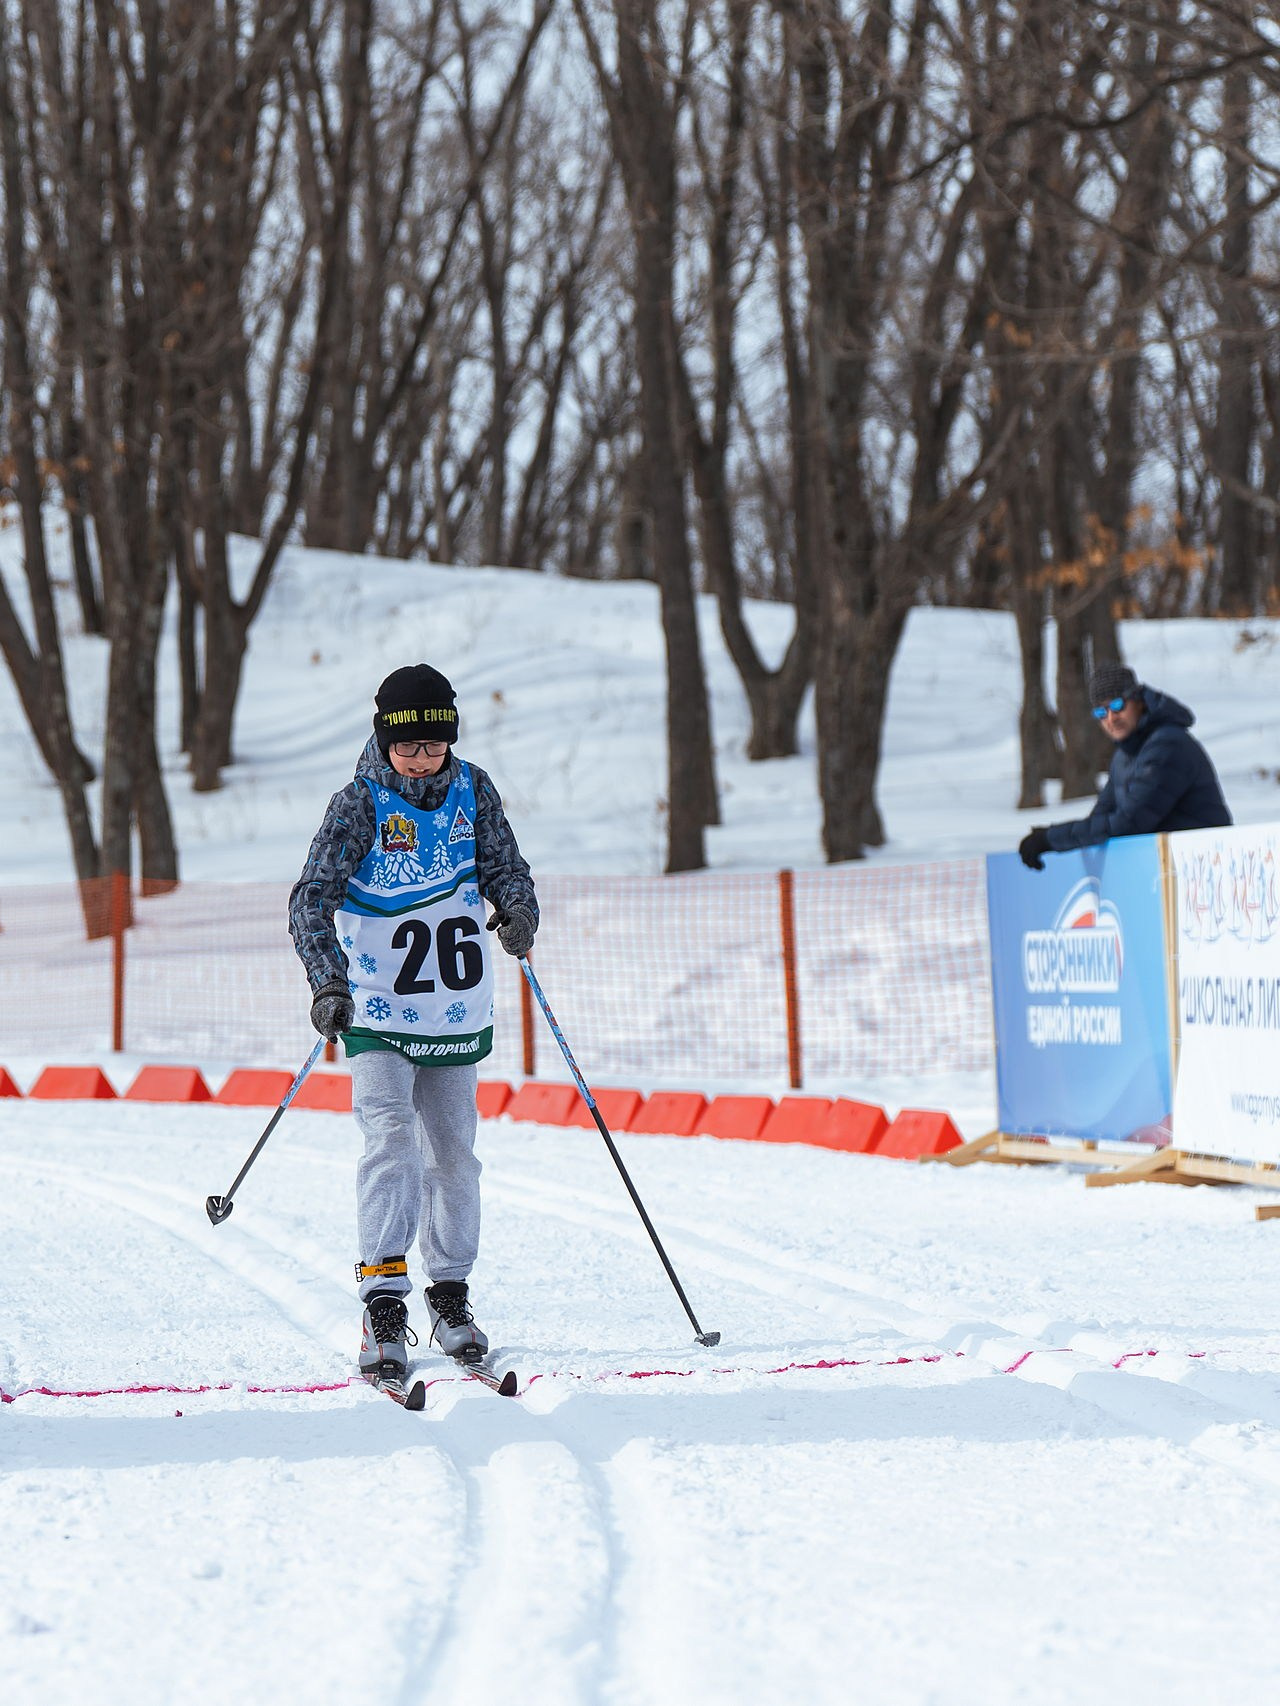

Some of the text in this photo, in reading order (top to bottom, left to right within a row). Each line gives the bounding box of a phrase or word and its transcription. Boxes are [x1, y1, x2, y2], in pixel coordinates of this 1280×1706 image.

[391, 916, 484, 995] 26
[1025, 936, 1118, 986] СТОРОННИКИ
[1027, 995, 1121, 1047] ЕДИНОЙ РОССИИ
